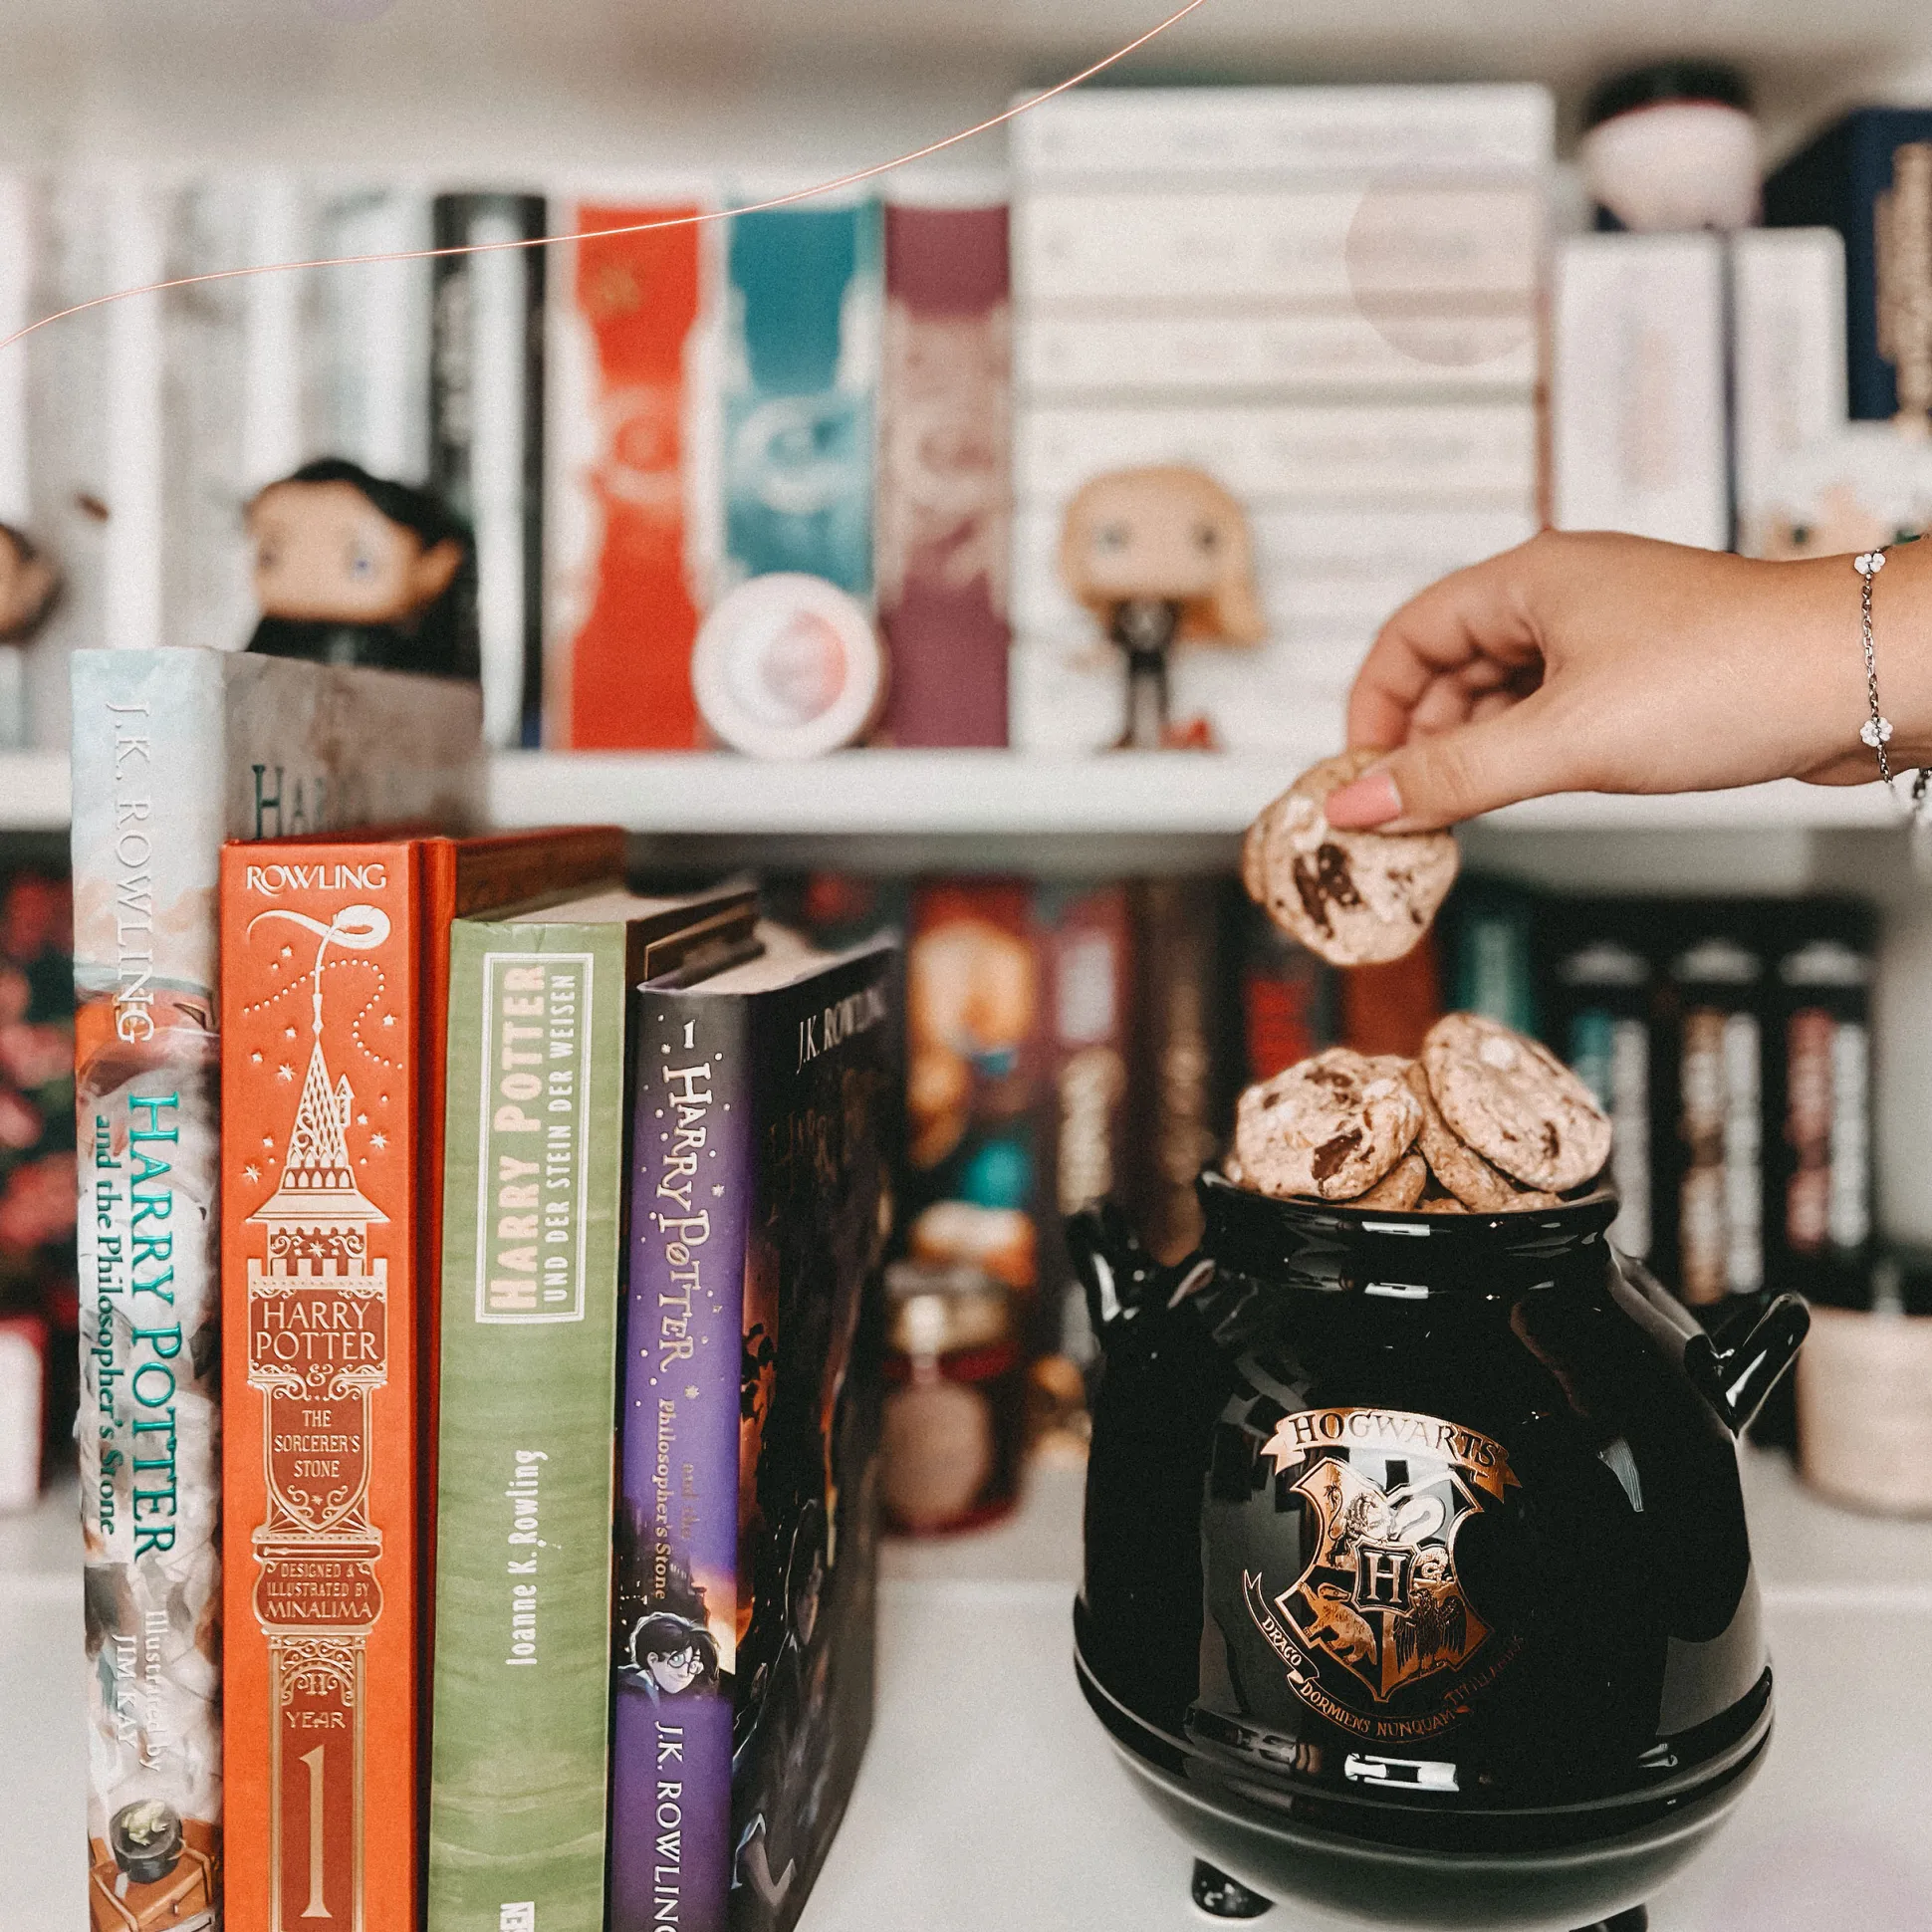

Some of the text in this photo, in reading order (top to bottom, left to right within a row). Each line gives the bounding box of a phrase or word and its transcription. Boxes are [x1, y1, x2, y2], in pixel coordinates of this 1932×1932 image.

[105, 701, 153, 1045] J.K. ROWLING
[246, 862, 387, 897] ROWLING
[489, 965, 546, 1310] HARRY POTTER
[543, 974, 577, 1303] UND DER STEIN DER WEISEN
[655, 1062, 714, 1373] HARRY POTTER
[90, 1114, 125, 1536] and the Philosopher's Stone
[128, 1090, 183, 1564] HARRY POTTER
[262, 1301, 371, 1330] HARRY
[255, 1330, 380, 1361] POTTER
[305, 1362, 335, 1387] &
[273, 1434, 361, 1453] SORCERER'S
[301, 1409, 333, 1428] THE
[1288, 1412, 1500, 1469] HOGWARTS
[293, 1459, 341, 1479] STONE
[505, 1449, 549, 1545] Rowling
[652, 1398, 677, 1600] Philosopher's Stone
[266, 1581, 369, 1598] ILLUSTRATED BY
[280, 1563, 342, 1578] DESIGNED
[507, 1552, 538, 1574] K.
[1361, 1551, 1407, 1604] H
[264, 1600, 373, 1619] MINALIMA
[112, 1633, 138, 1750] JIM KAY
[1261, 1616, 1303, 1668] DRACO
[1299, 1676, 1370, 1734] DORMIENS
[1375, 1706, 1457, 1738] NUNQUAM
[285, 1710, 347, 1729] YEAR
[138, 1742, 168, 1773] by
[298, 1743, 334, 1919] 1
[653, 1720, 684, 1932] J.K. ROWLIN
